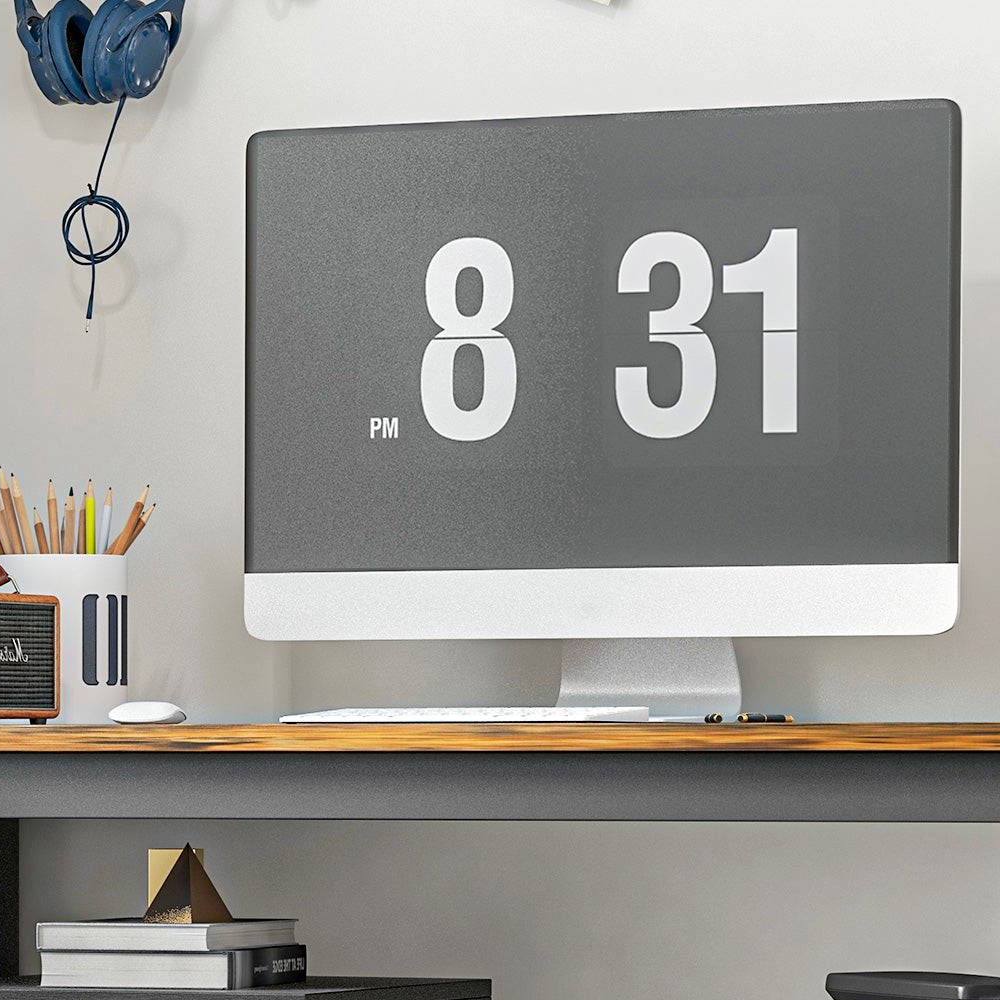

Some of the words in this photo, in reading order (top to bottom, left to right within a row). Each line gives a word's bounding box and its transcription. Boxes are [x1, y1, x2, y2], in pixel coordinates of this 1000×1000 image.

[369, 417, 399, 439] PM
[420, 237, 517, 442] 8
[614, 228, 798, 440] 31
